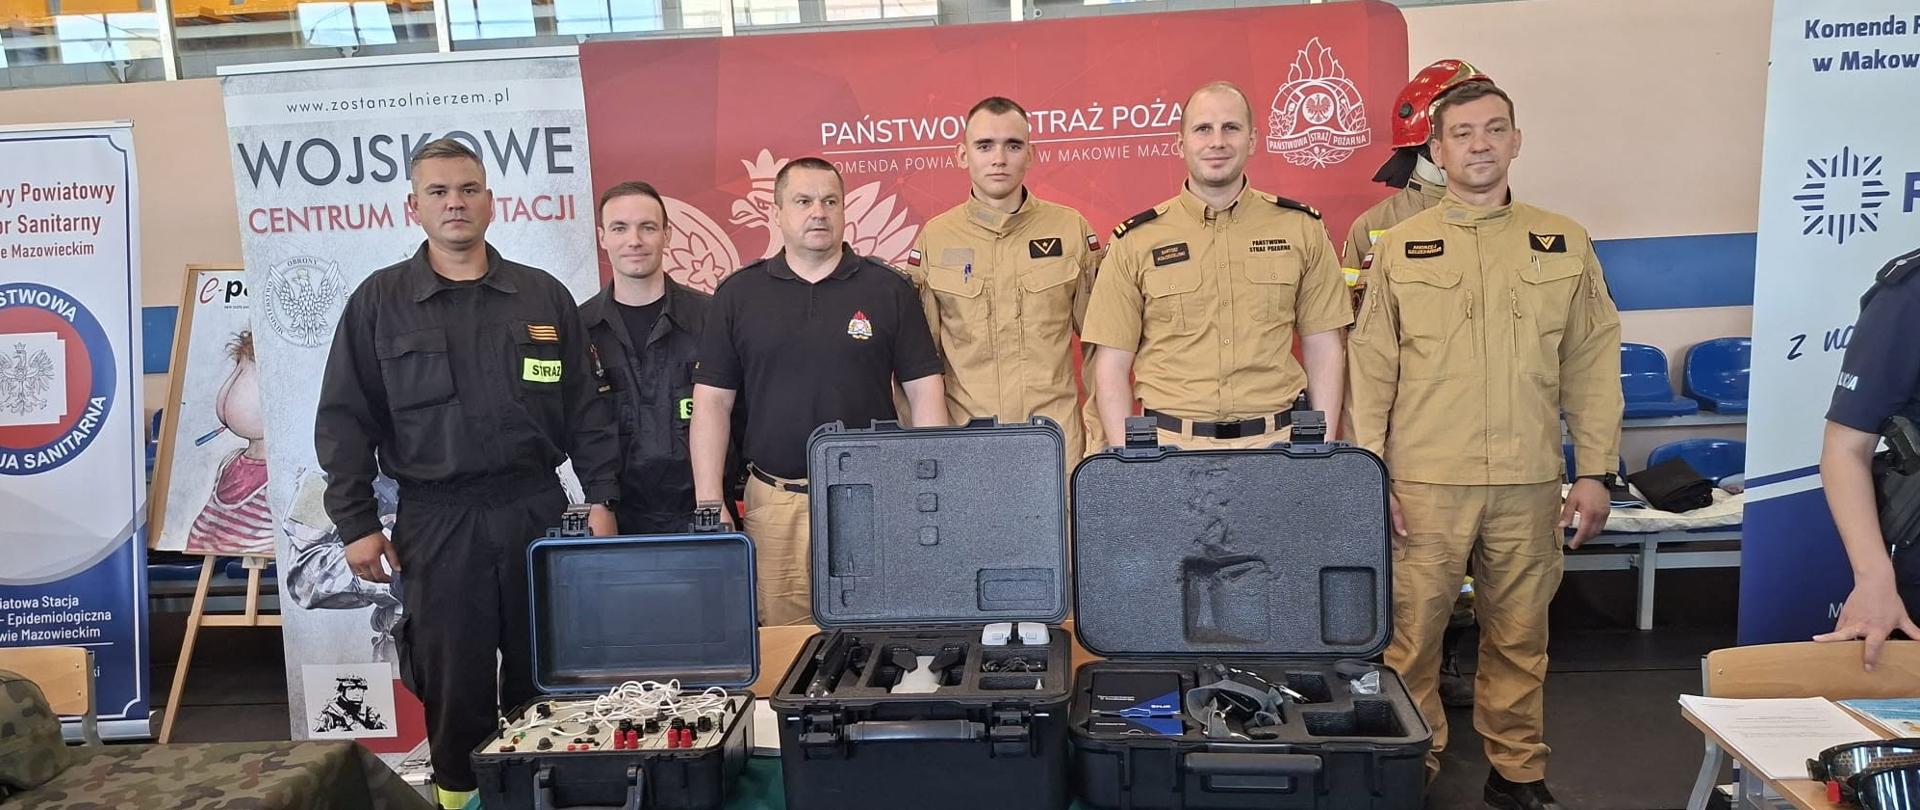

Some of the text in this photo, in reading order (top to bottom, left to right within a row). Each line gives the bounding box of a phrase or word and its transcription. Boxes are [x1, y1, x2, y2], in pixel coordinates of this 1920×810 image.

[1804, 14, 1907, 39] Komenda
[1812, 57, 1833, 72] w
[287, 87, 510, 112] www.zostanzolnierzem.pl
[821, 114, 967, 146] PAŃSTWO
[1112, 98, 1182, 129] POŻA
[832, 143, 1179, 175] OMENDA POWIA W MAKOWIE MAZO
[21, 182, 115, 205] Powiatowy
[18, 213, 101, 235] Sanitarny
[249, 202, 394, 234] CENTRUM
[12, 241, 94, 258] Mazowieckim
[24, 396, 107, 469] SANITARNA
[42, 594, 79, 609] Stacja
[8, 610, 112, 627] Epidemiologiczna
[21, 626, 100, 641] Mazowieckim
